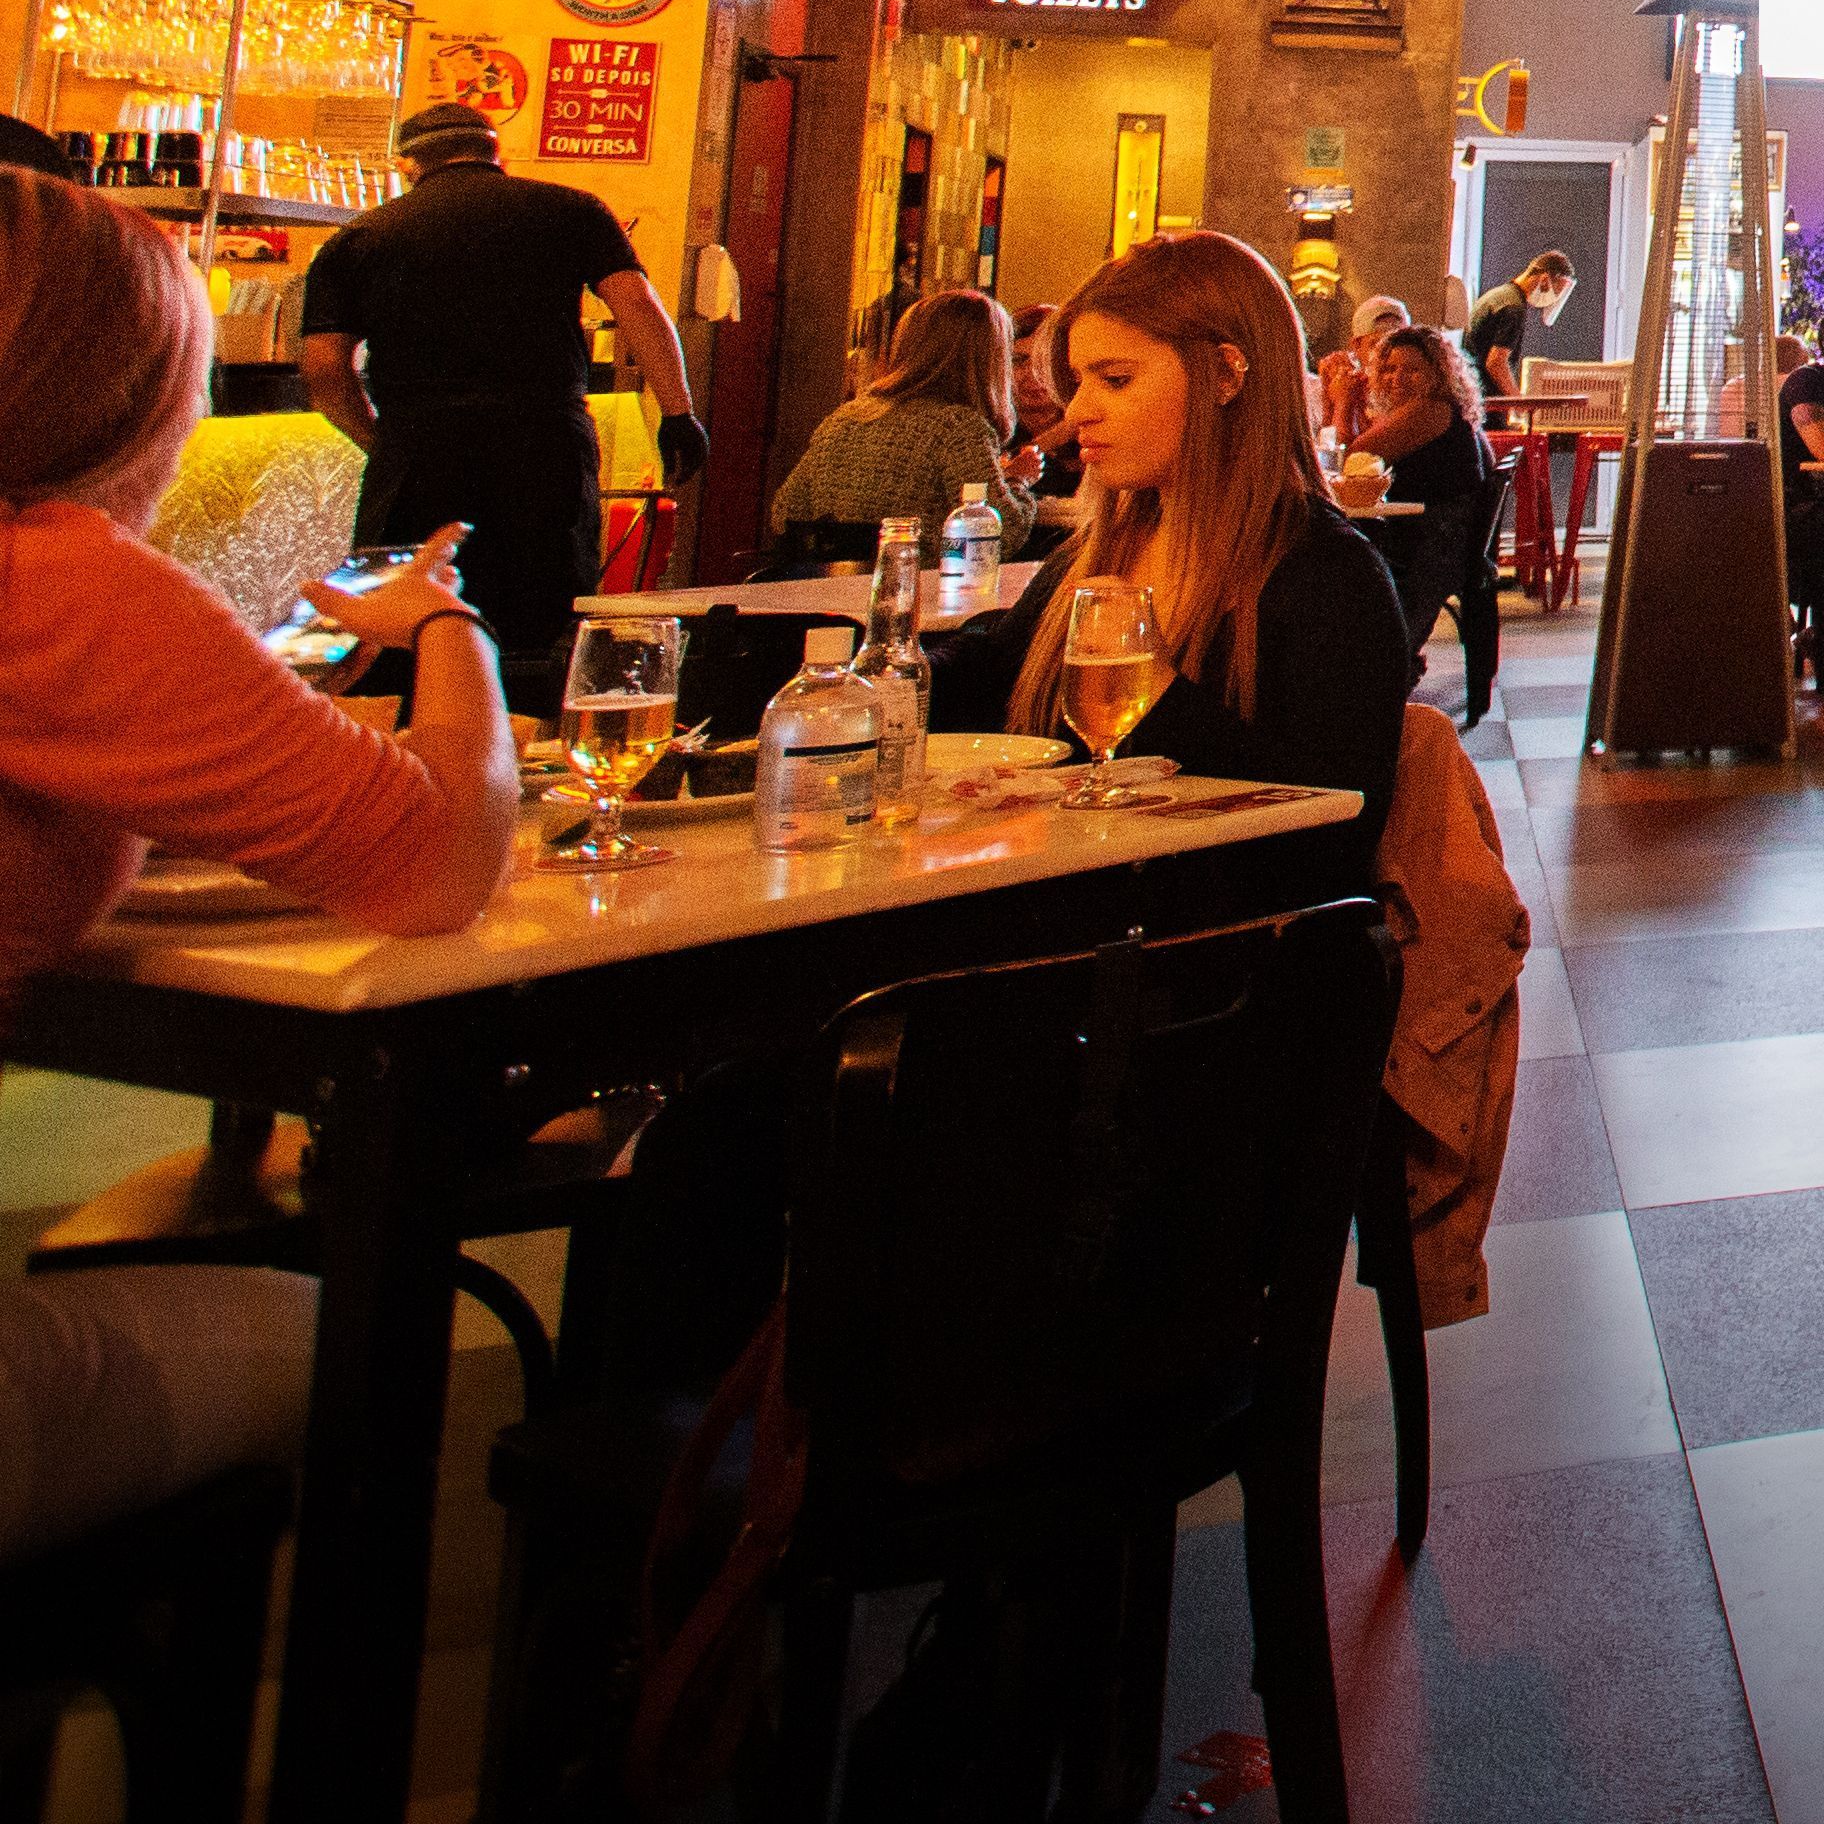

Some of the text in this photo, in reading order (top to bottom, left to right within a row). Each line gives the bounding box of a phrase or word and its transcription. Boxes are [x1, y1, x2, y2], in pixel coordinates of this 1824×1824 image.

[568, 43, 640, 67] WI-FI
[551, 65, 652, 86] SÓ DEPOIS
[549, 100, 643, 122] 30 MIN
[546, 135, 639, 155] CONVERSA
